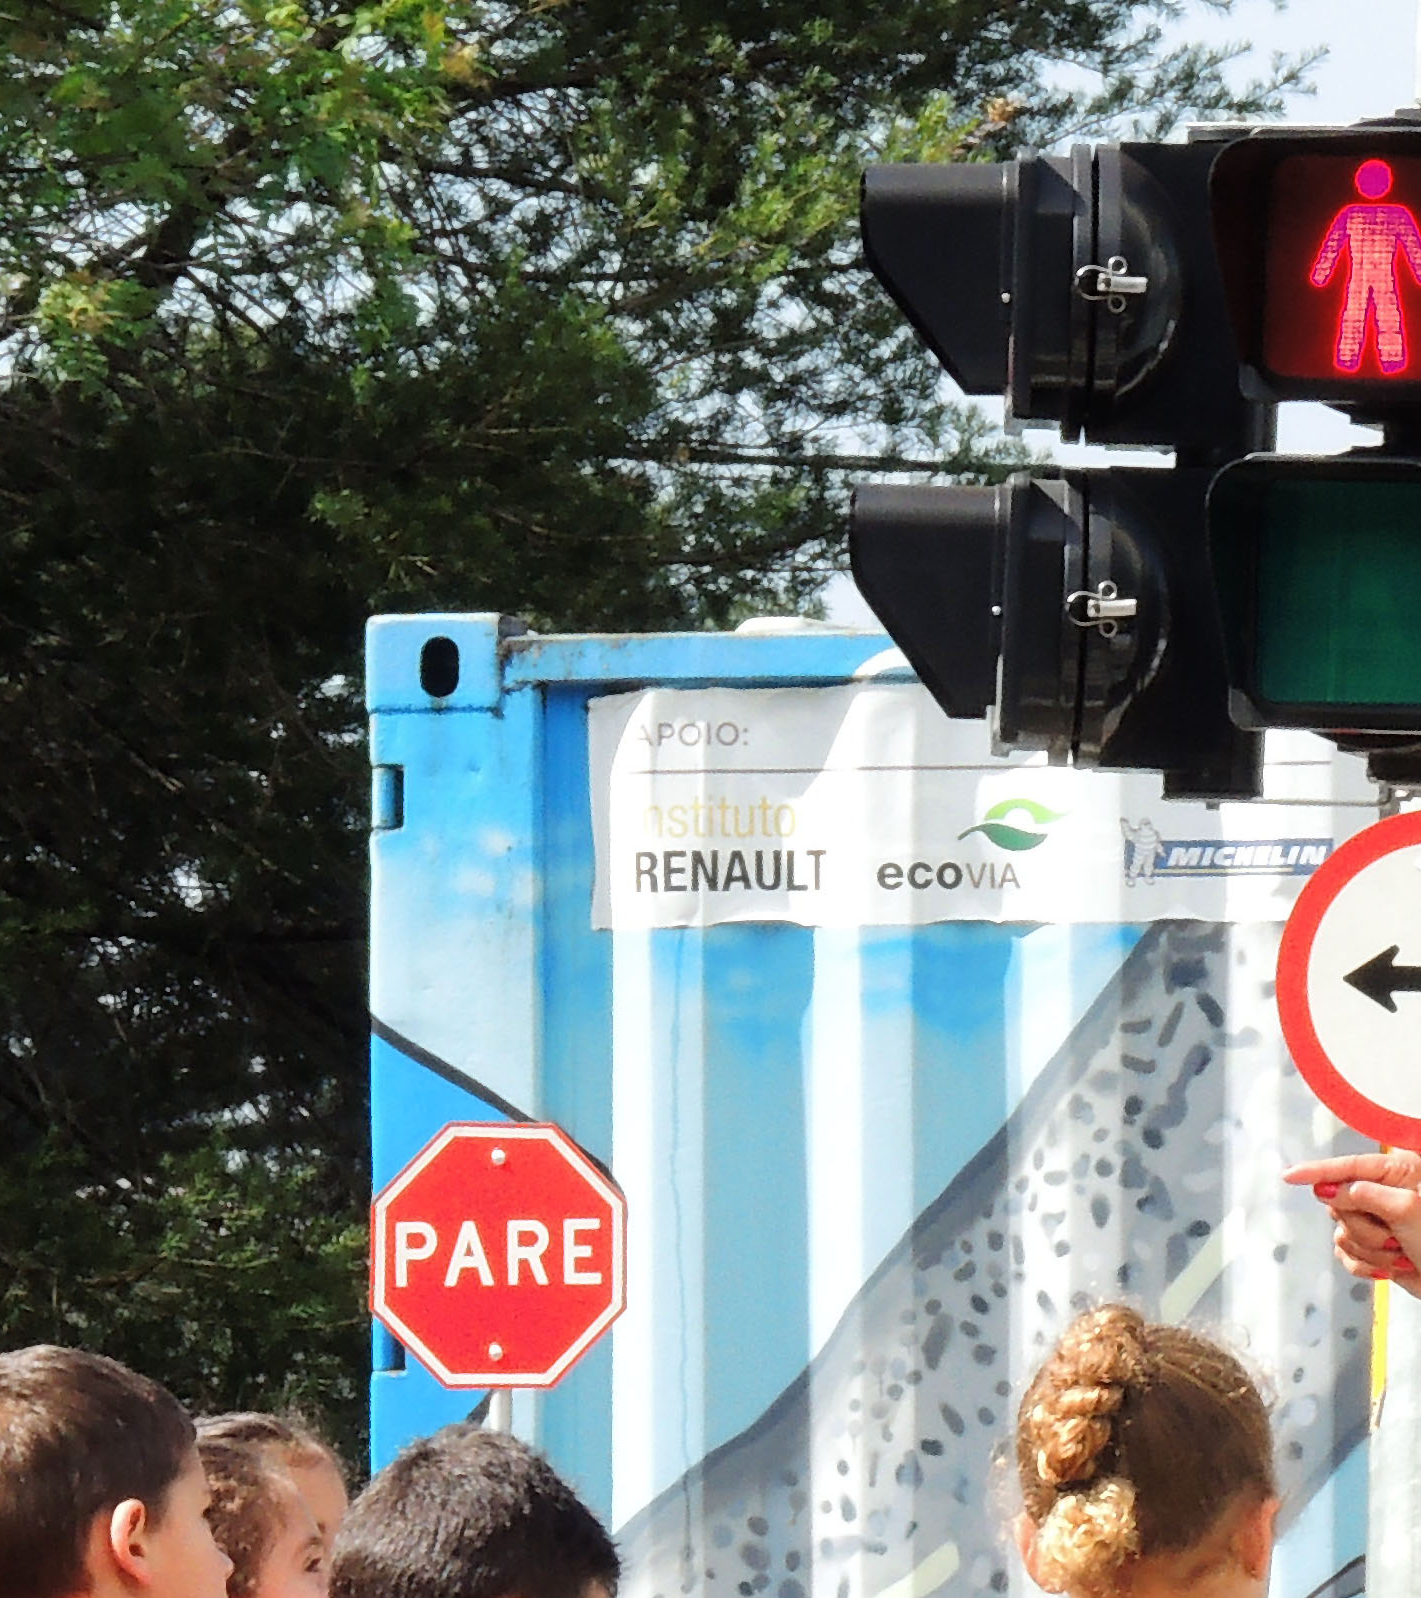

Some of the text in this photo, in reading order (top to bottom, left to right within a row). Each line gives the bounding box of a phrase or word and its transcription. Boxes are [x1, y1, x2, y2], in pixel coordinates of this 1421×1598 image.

[643, 795, 796, 838] nstituto
[635, 849, 827, 892] RENAULT
[877, 861, 1021, 890] ecoVIA
[1167, 845, 1327, 866] MICHELIN
[394, 1218, 602, 1287] PARE
